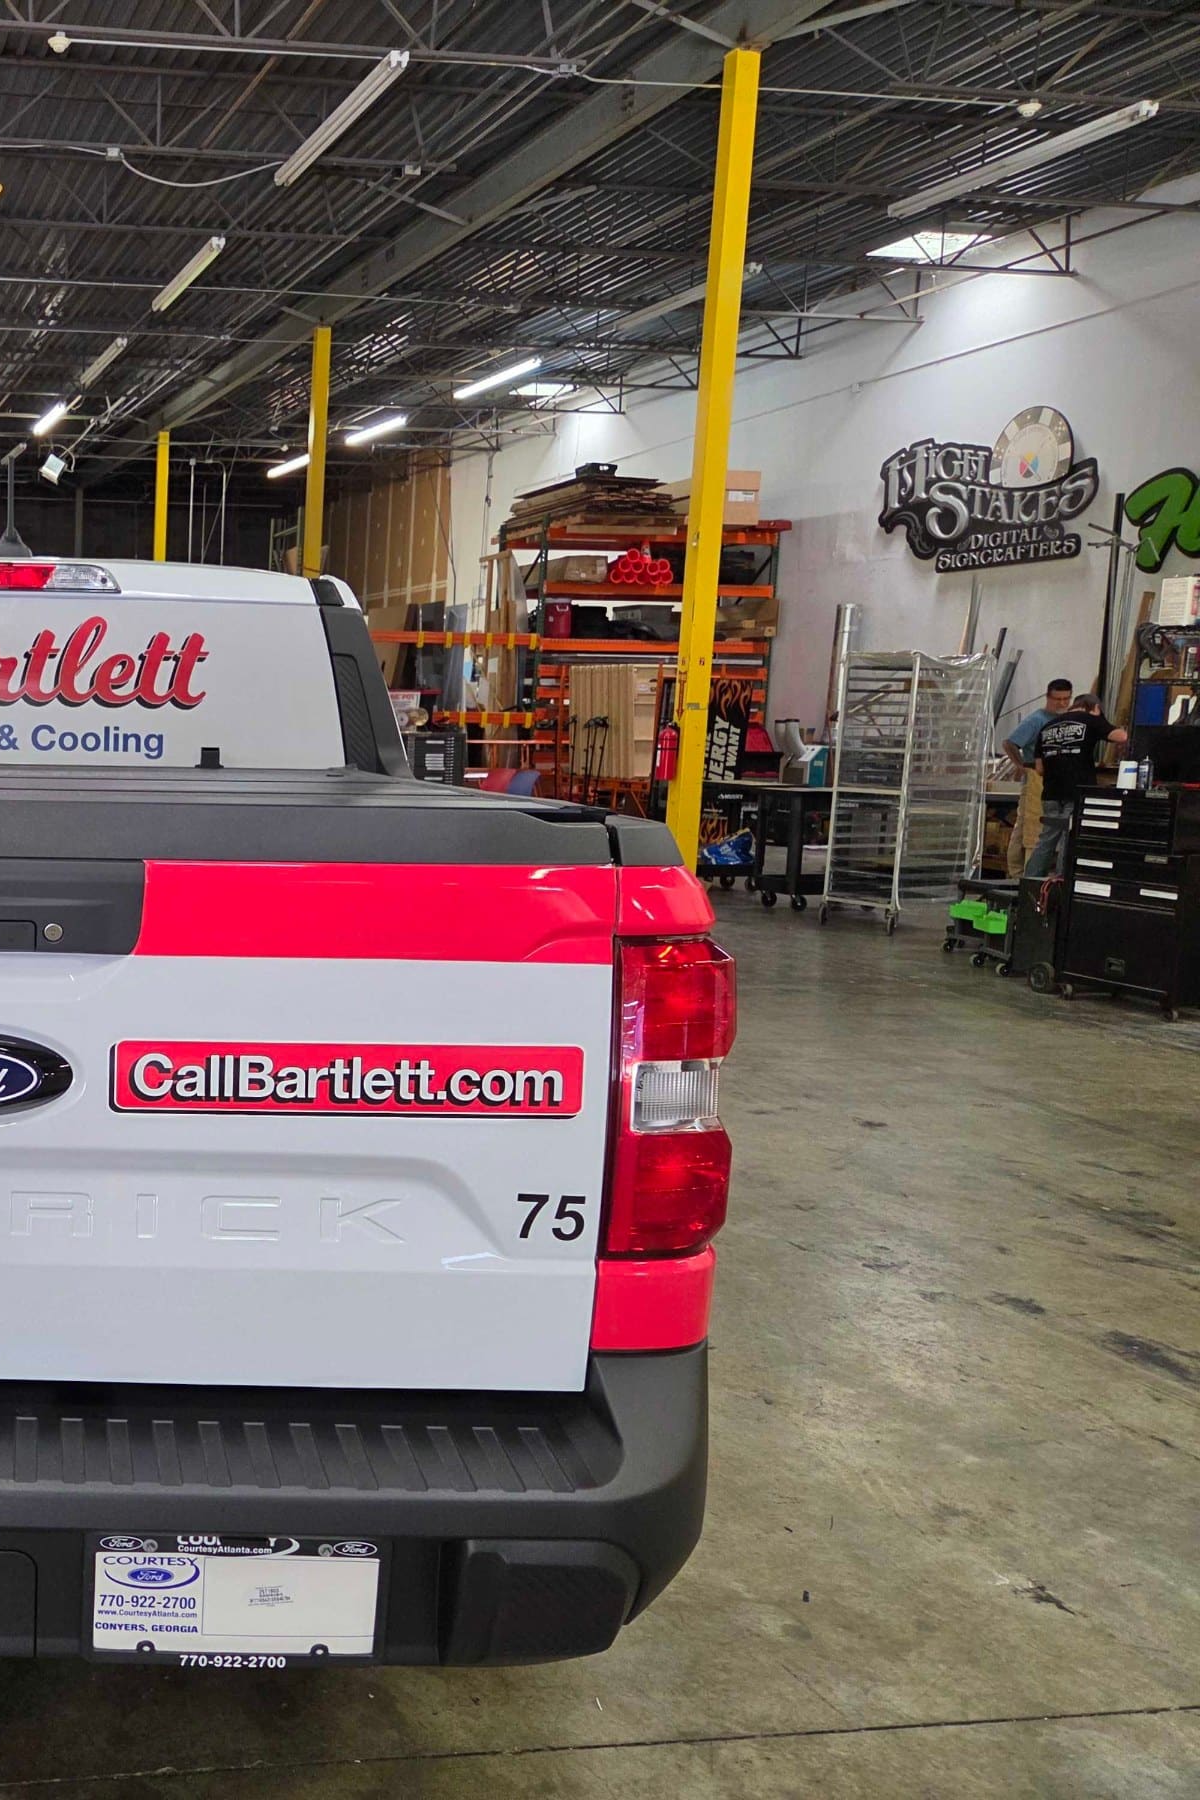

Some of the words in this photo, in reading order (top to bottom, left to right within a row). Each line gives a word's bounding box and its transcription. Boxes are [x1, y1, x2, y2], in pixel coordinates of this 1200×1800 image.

[884, 444, 990, 515] HIGH
[924, 466, 1095, 540] STAKES
[970, 526, 1043, 550] DIGITAL
[938, 537, 1077, 571] SIGNCRAFTERS
[30, 724, 165, 760] Cooling
[725, 725, 741, 767] WANT
[128, 1052, 564, 1109] CallBartlett.com
[516, 1193, 587, 1242] 75
[108, 1536, 135, 1548] Ford
[177, 1545, 273, 1555] CourtesyAtlanta.com
[341, 1543, 369, 1554] Ford
[103, 1556, 198, 1566] COURTESY
[136, 1570, 164, 1581] Ford
[99, 1594, 196, 1610] 770-922-2700
[97, 1609, 198, 1619] www.CourtesyAtlanta.com
[95, 1622, 148, 1633] CONYERS,
[151, 1624, 198, 1633] GEORGIA
[179, 1654, 287, 1668] 770-922-2700
